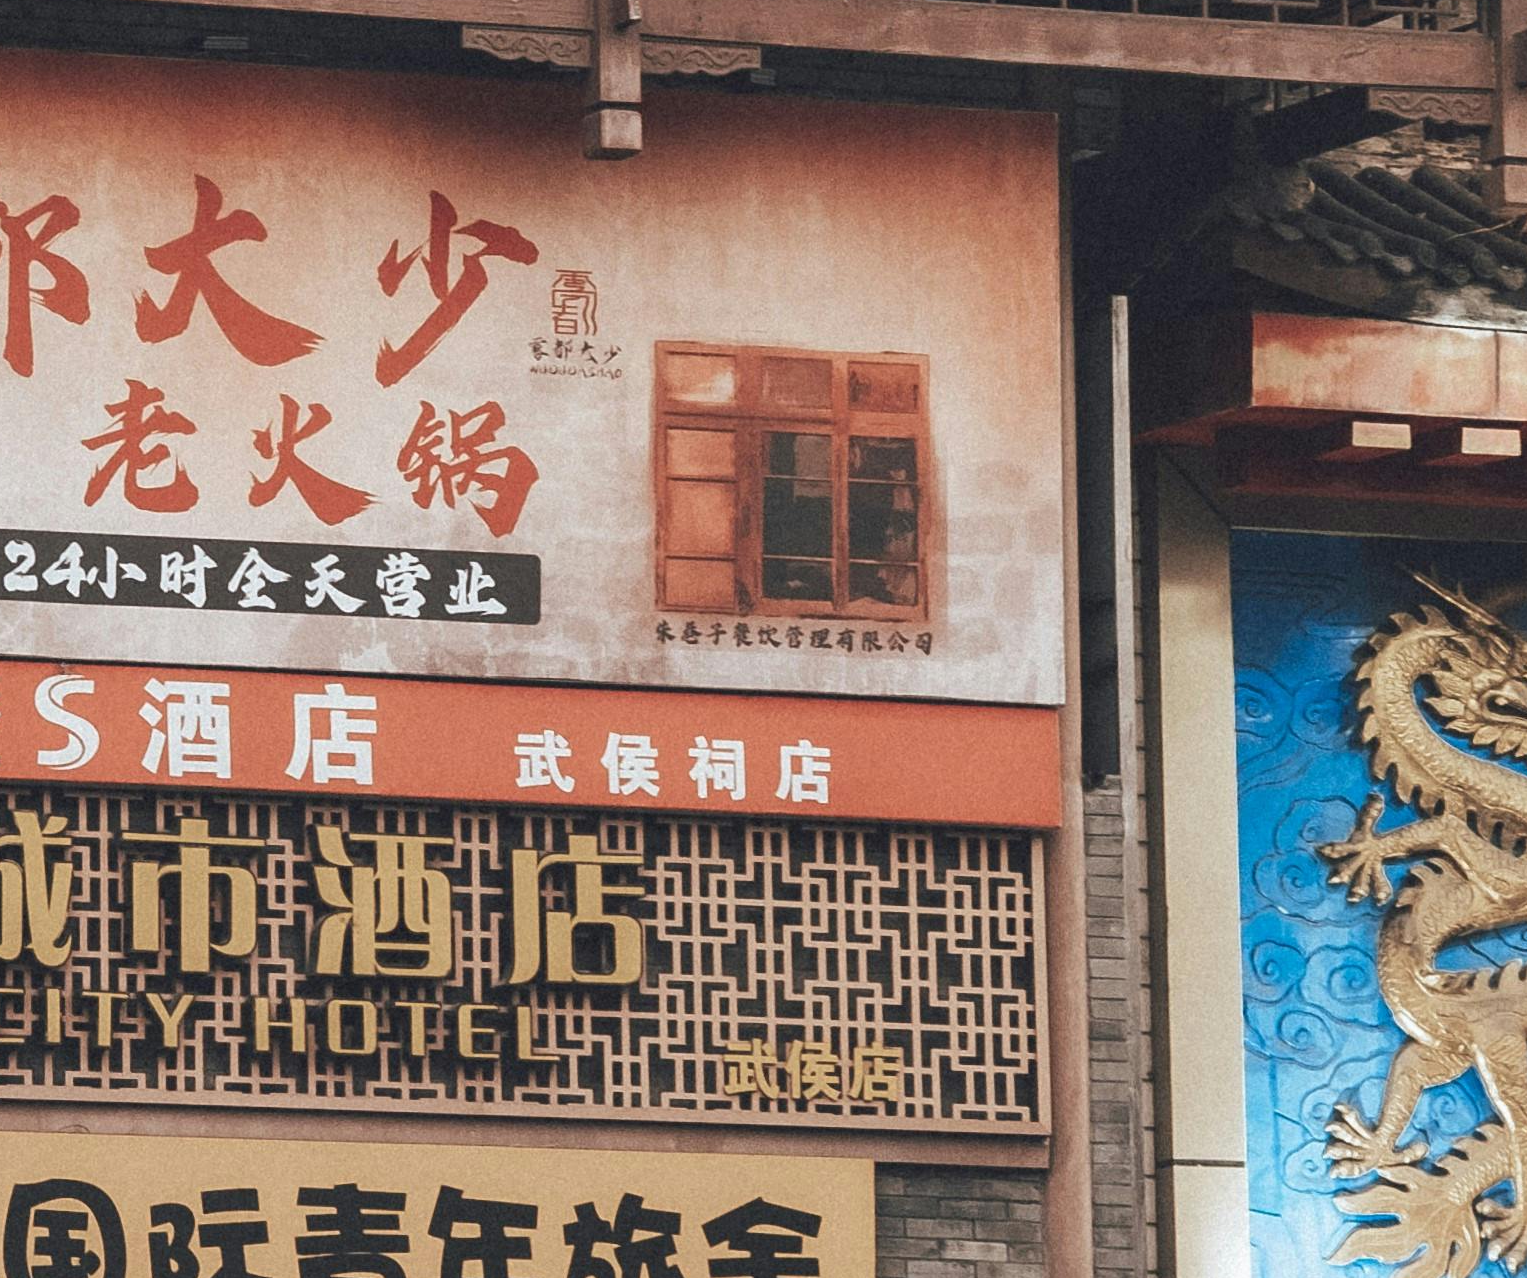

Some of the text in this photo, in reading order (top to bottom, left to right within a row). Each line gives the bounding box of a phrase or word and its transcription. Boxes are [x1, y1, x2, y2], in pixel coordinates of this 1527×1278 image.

[82, 377, 541, 538] 老火锅
[0, 538, 514, 621] 24小时全天营业
[512, 732, 833, 808] 武侯祠店
[253, 996, 561, 1062] HOTEL
[723, 1038, 903, 1102] 武侯店
